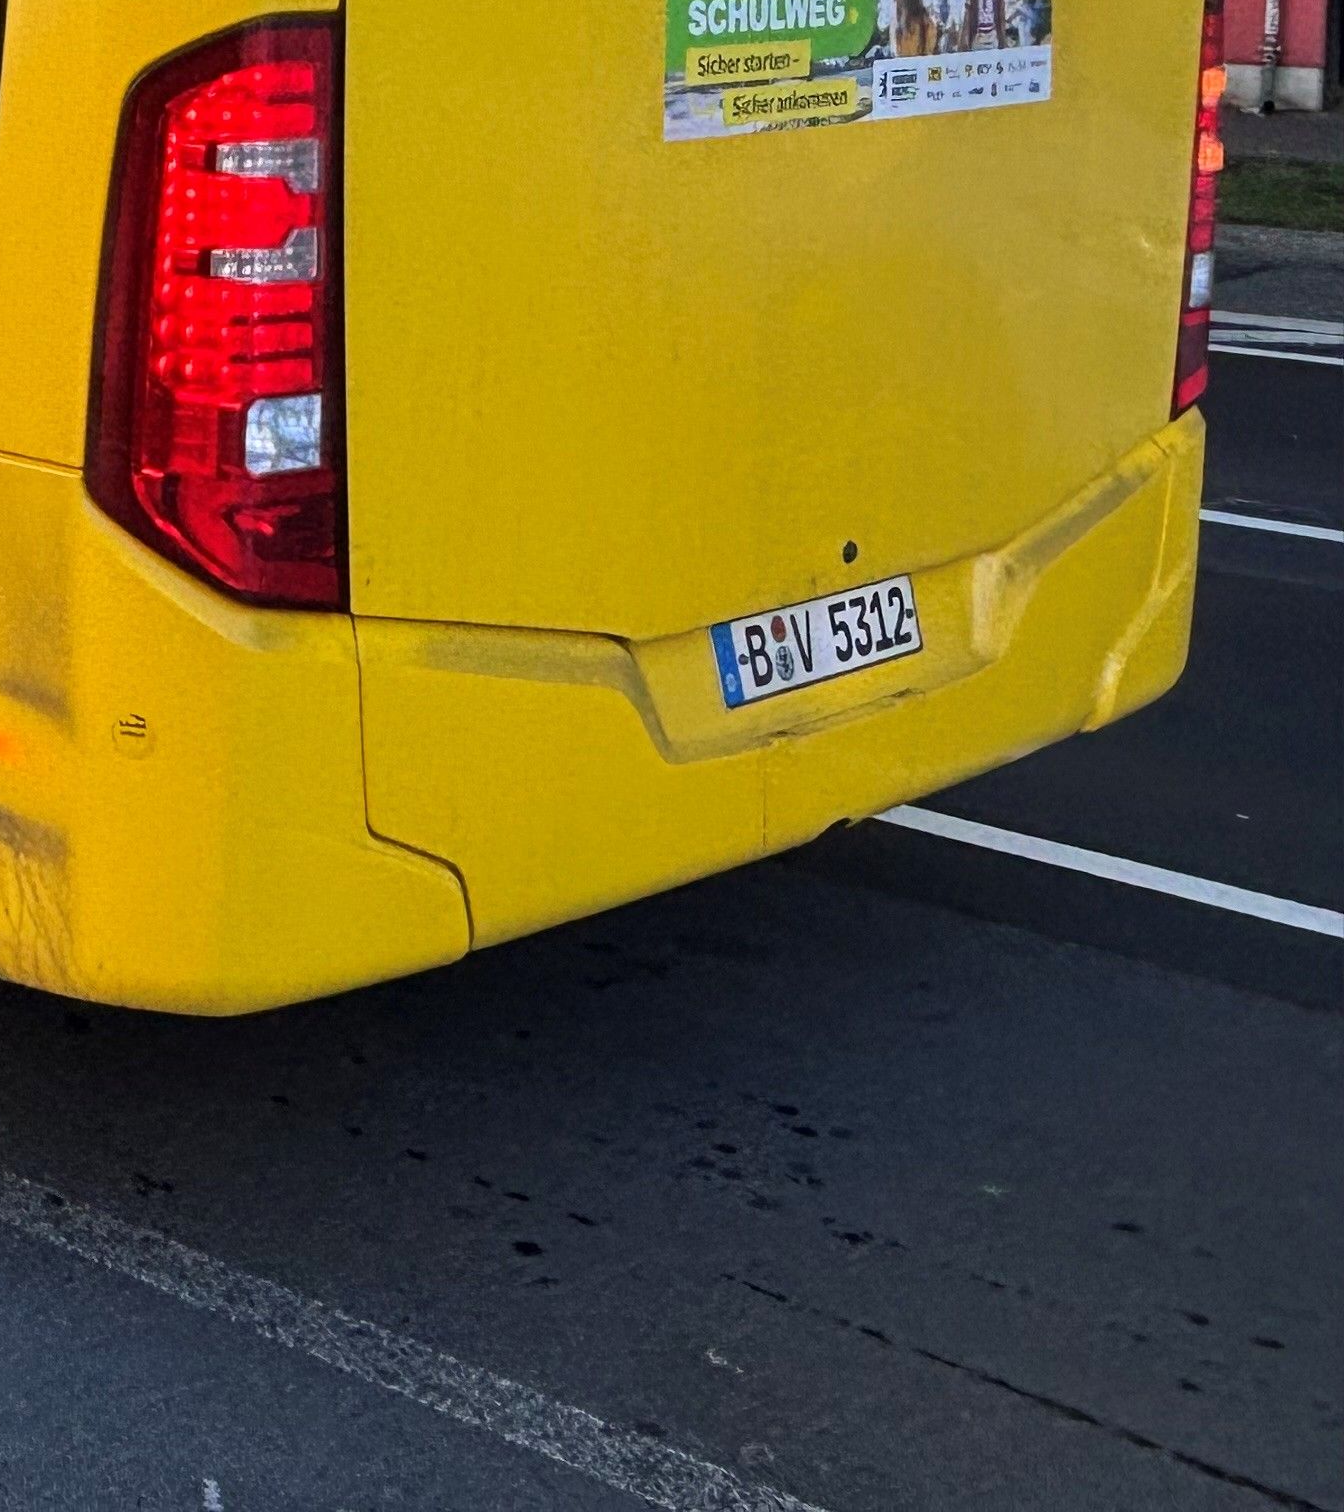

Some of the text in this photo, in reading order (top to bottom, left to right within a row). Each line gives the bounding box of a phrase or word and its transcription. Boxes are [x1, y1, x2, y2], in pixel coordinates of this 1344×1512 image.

[697, 53, 741, 77] Sicher
[744, 586, 913, 688] B V 5312
